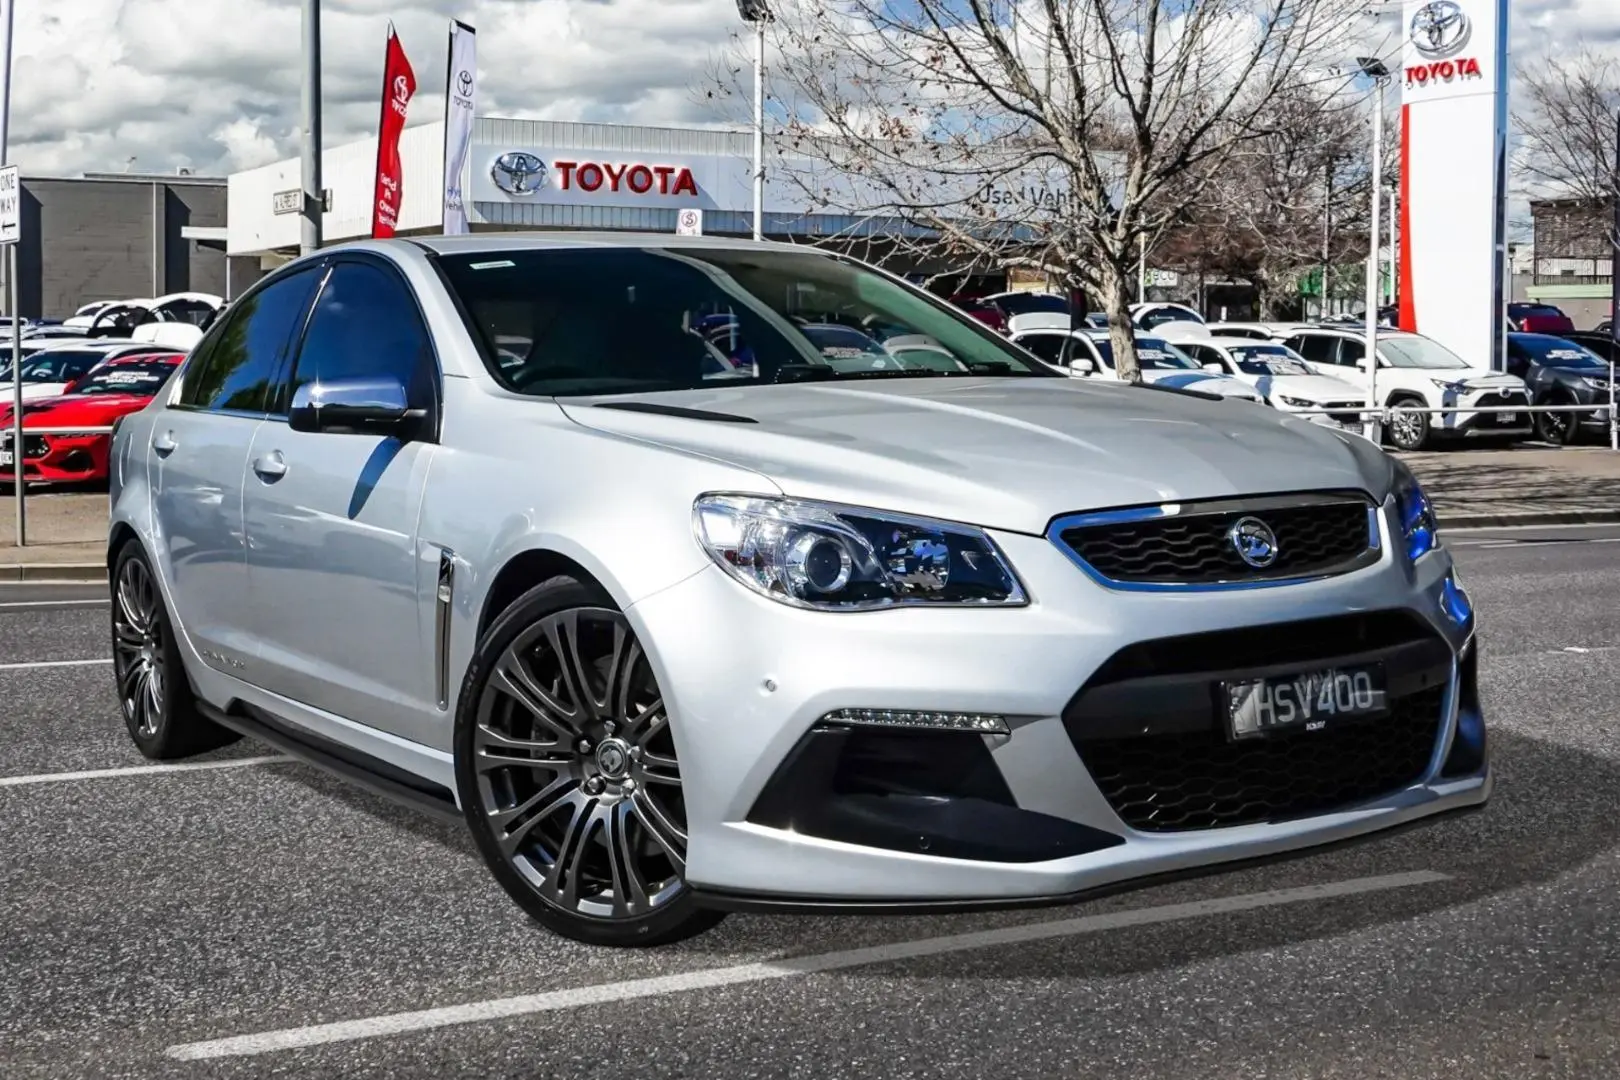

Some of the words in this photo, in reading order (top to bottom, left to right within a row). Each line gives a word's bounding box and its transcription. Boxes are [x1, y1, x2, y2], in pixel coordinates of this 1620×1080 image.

[1404, 58, 1480, 83] TOYOTA
[0, 172, 15, 192] ONE
[554, 161, 699, 197] TOYOTA
[0, 196, 17, 214] WAY
[1254, 671, 1373, 727] HSV400
